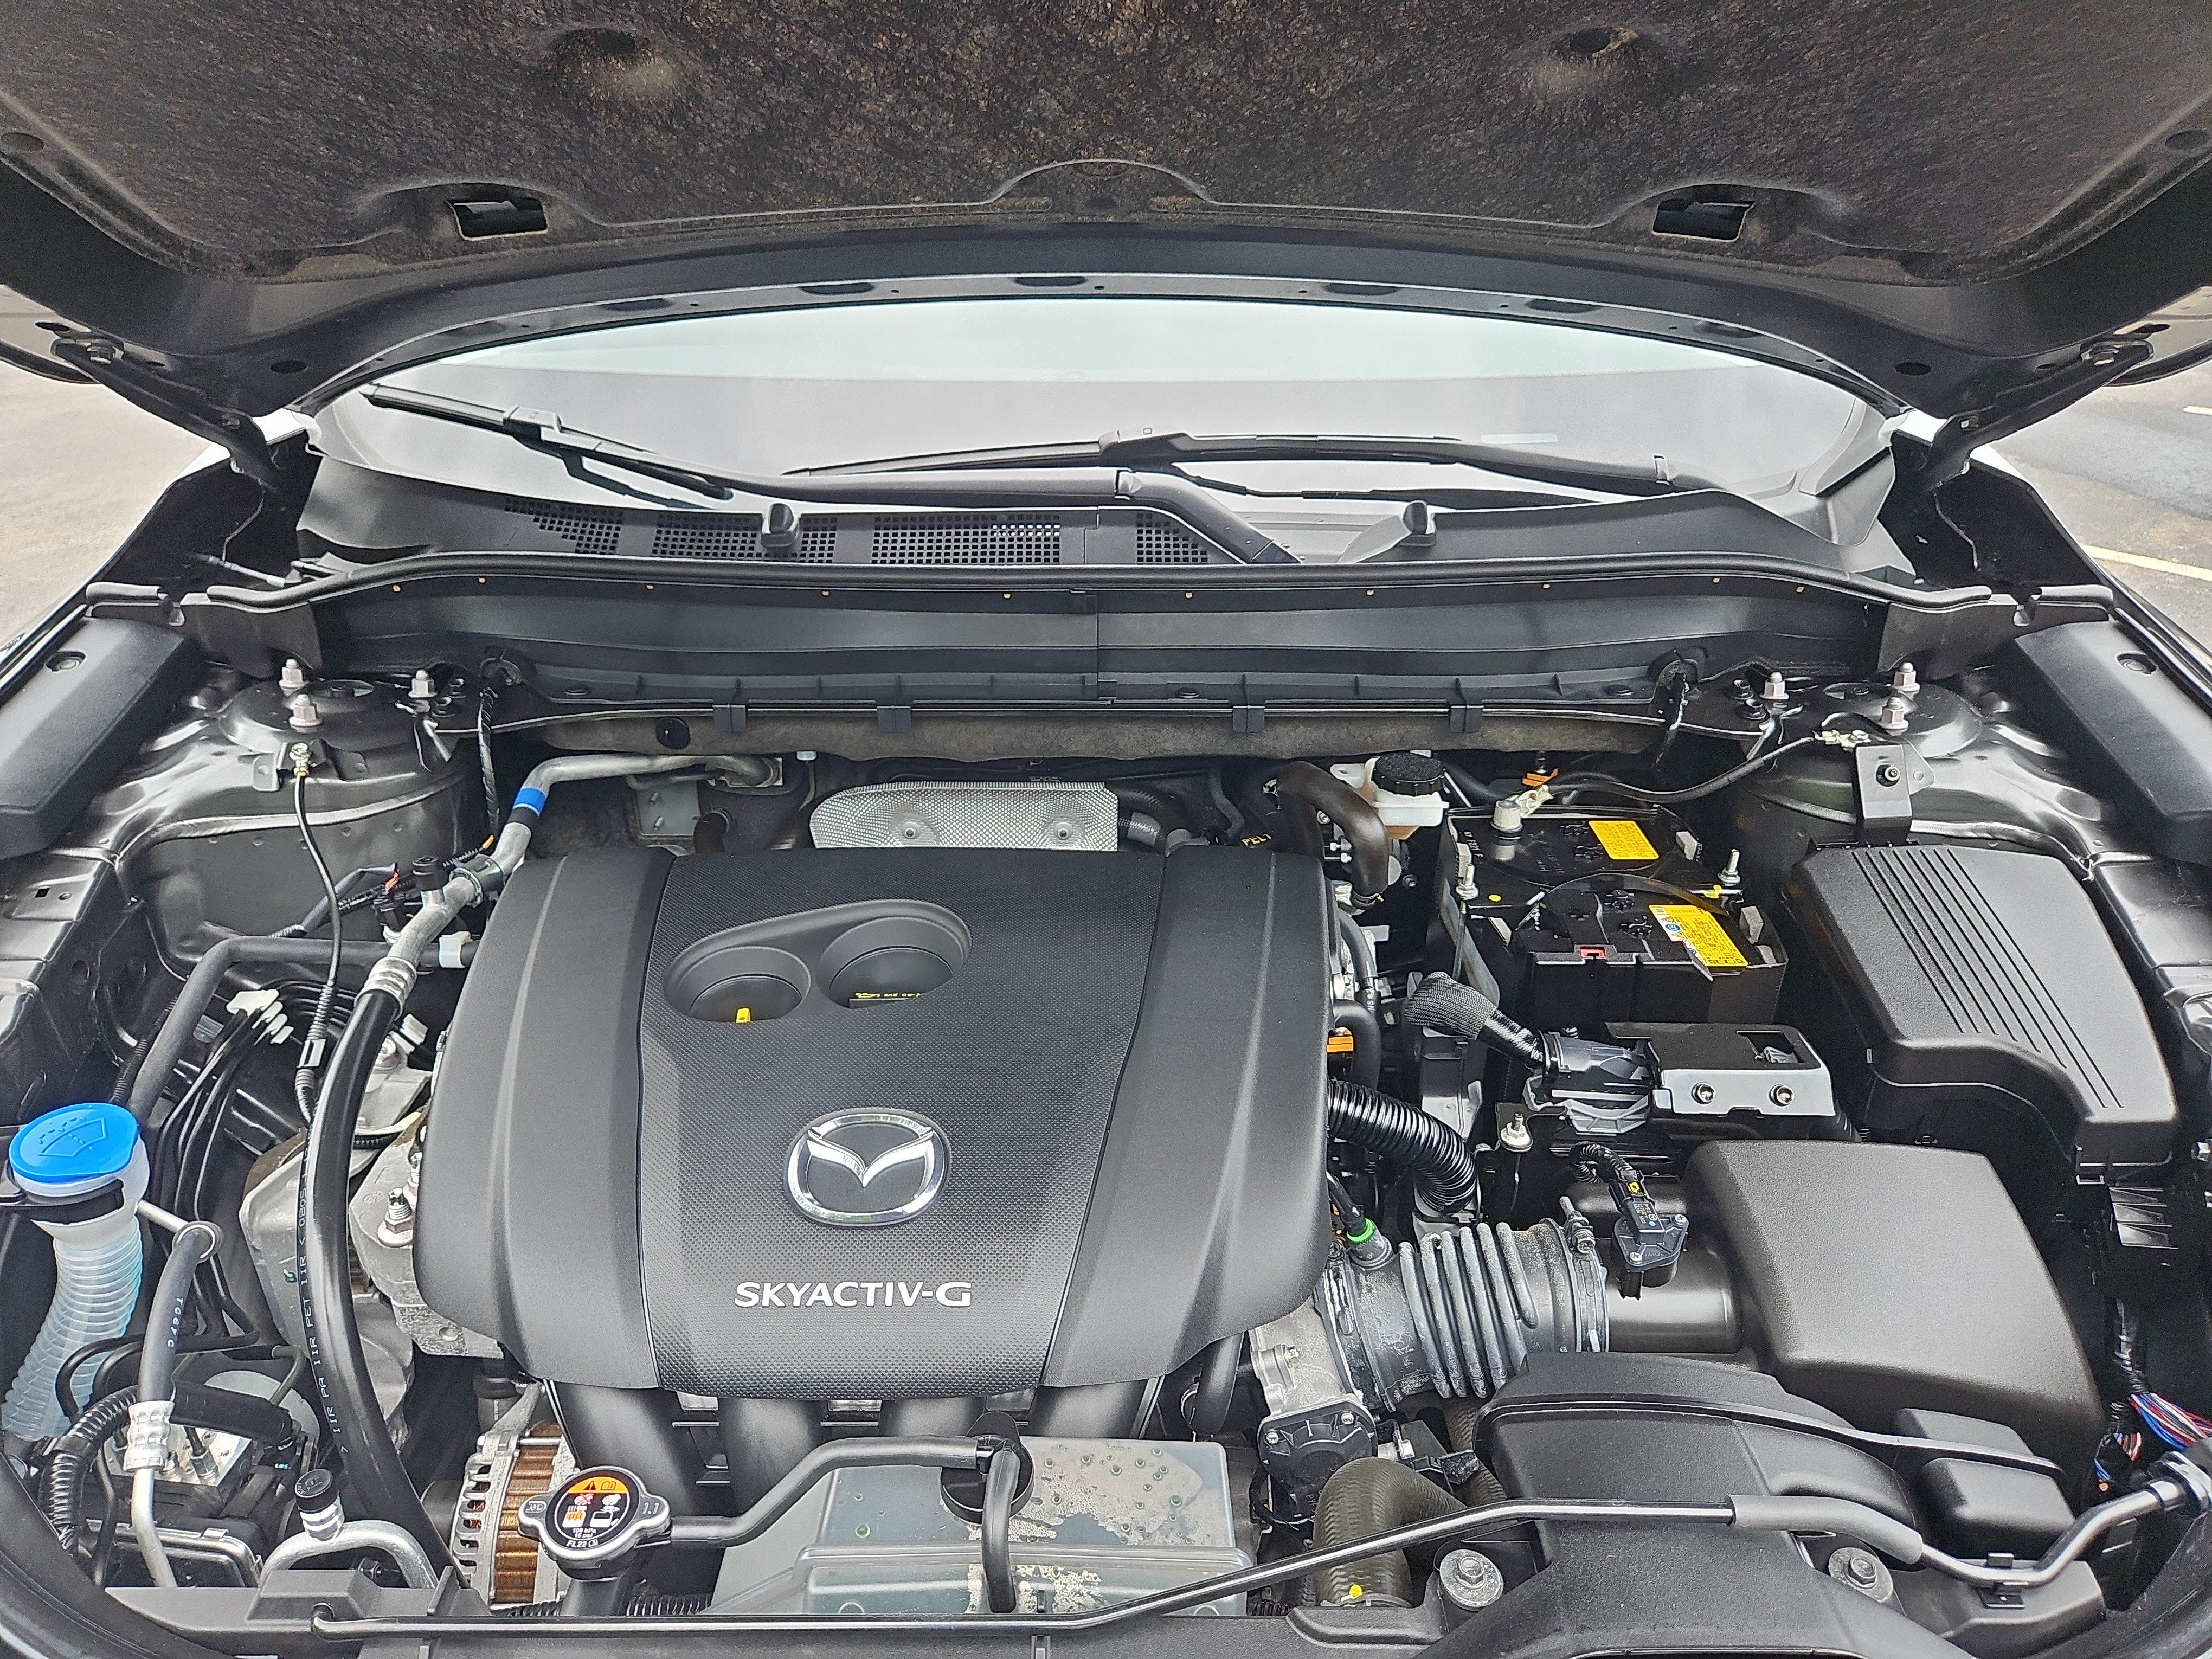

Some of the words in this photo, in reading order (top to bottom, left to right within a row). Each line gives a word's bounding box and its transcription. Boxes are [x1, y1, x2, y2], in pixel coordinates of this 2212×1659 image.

[298, 1188, 307, 1227] 0805
[734, 1280, 972, 1308] SKYACTIV-G
[303, 1296, 314, 1328] PET
[318, 1377, 330, 1398] PA
[642, 1502, 660, 1515] 1.1
[566, 1540, 588, 1548] FL22
